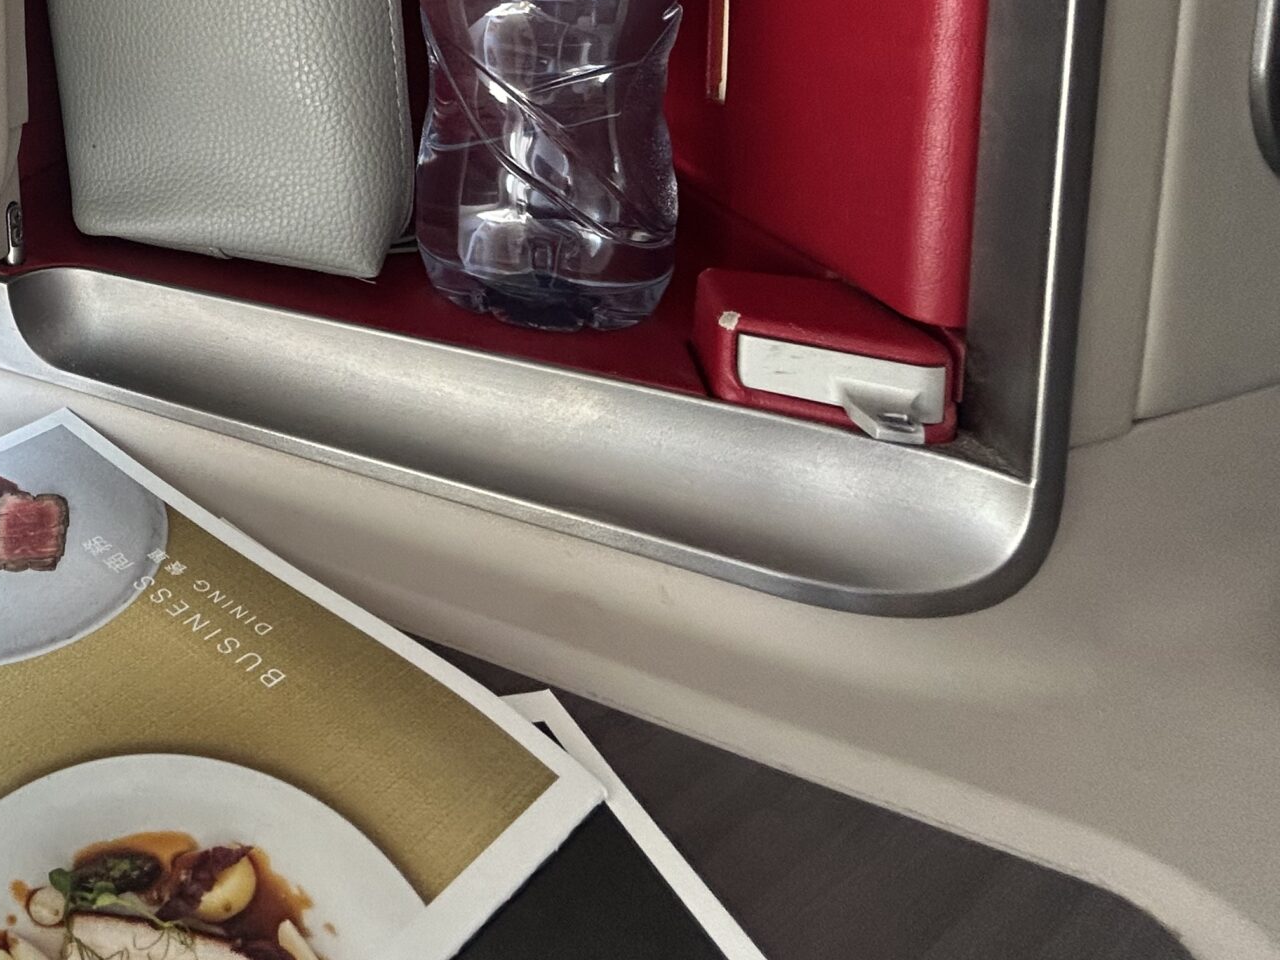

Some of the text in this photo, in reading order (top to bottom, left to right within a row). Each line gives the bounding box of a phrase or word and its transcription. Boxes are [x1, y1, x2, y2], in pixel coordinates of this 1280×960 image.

[82, 535, 286, 688] BUSINESS 商務
[193, 579, 273, 636] DINING
